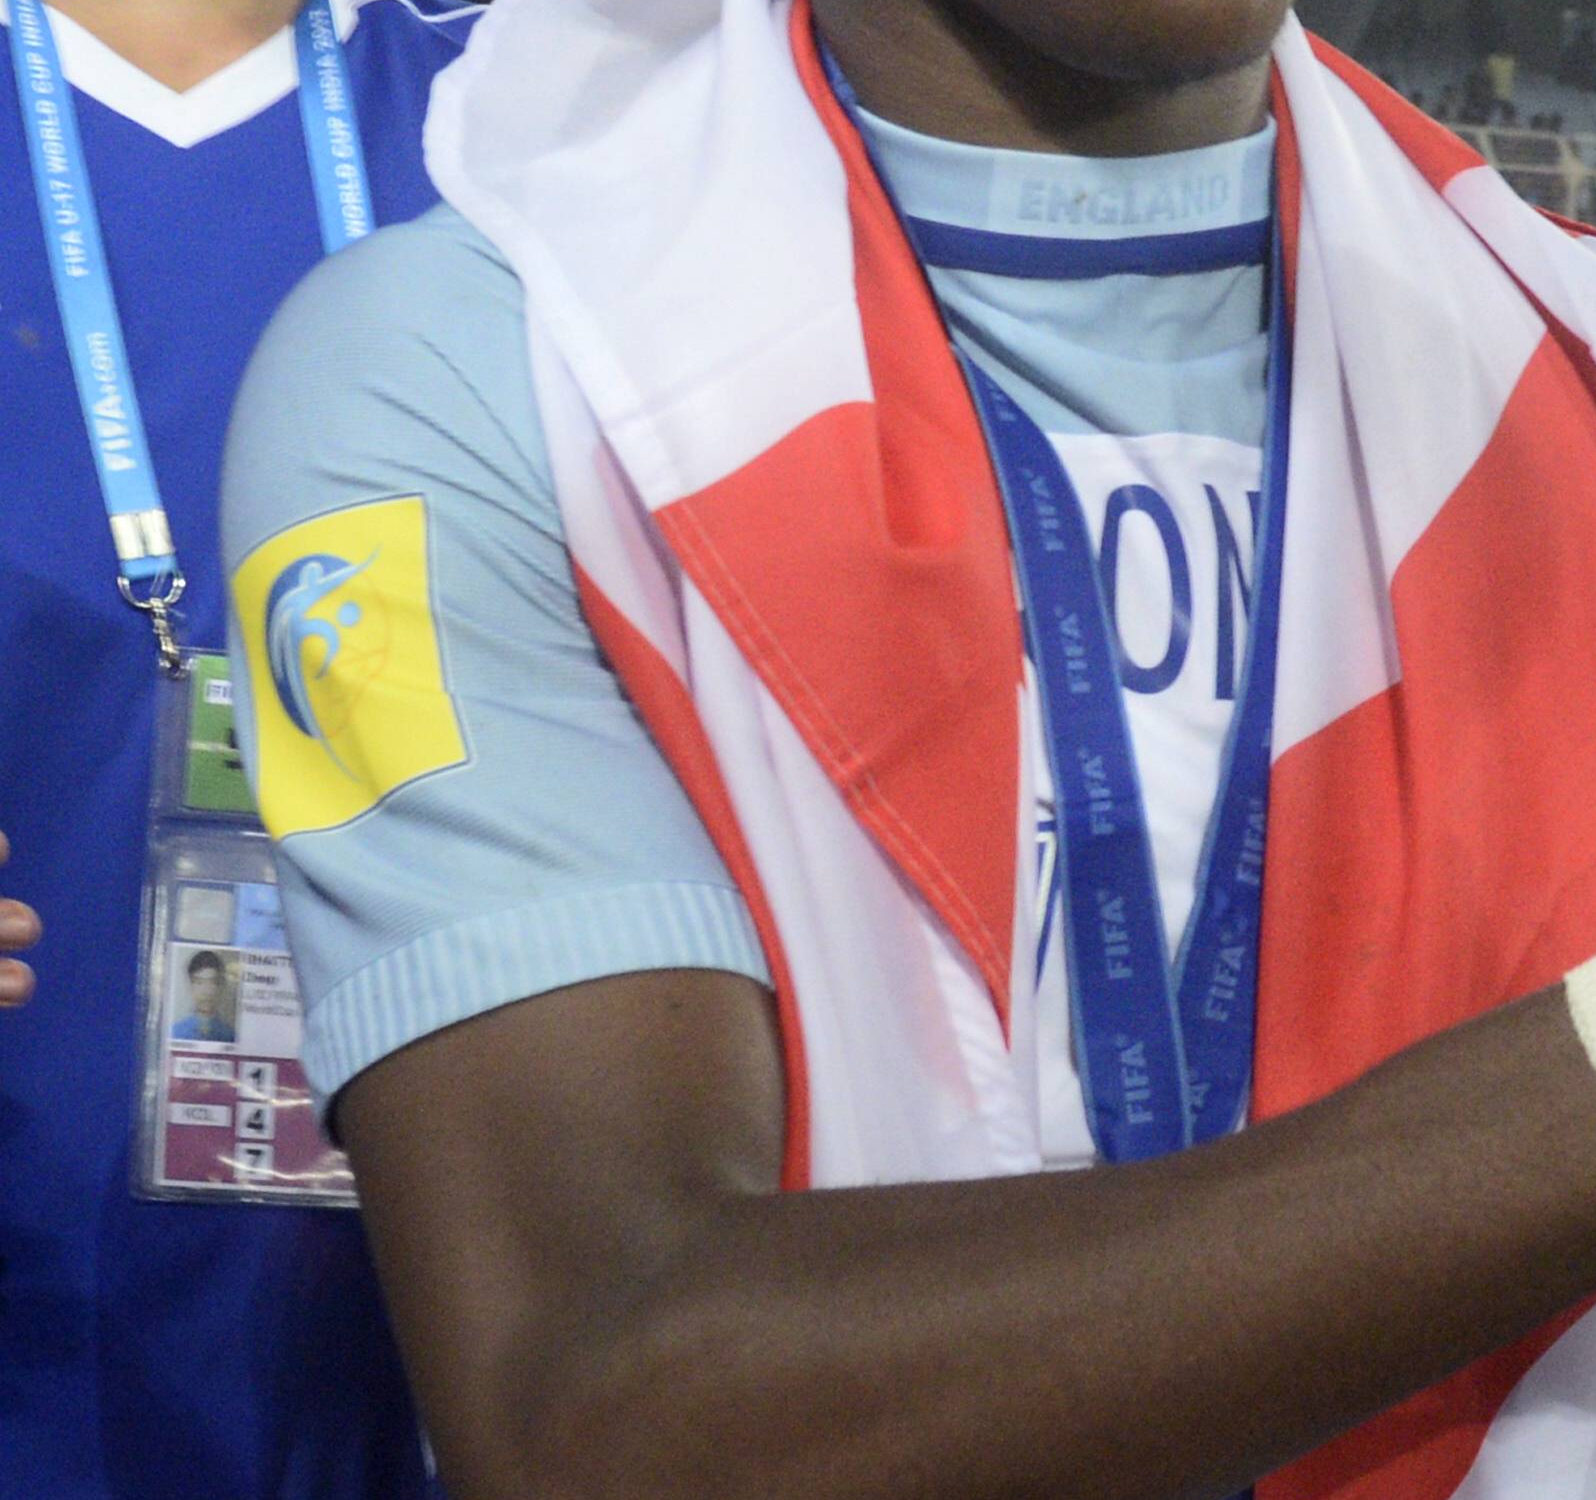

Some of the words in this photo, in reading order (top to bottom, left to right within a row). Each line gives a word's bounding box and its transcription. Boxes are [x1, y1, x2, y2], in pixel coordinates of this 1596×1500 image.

[26, 51, 54, 95] CUP
[316, 53, 348, 113] INDIA
[35, 97, 69, 174] WORLD
[327, 115, 354, 159] CUP
[50, 179, 80, 226] U-17
[334, 162, 369, 238] WORLD
[1016, 173, 1229, 225] ENGLAND
[59, 230, 89, 278] FIFA
[1060, 611, 1092, 695] FIFA
[1083, 753, 1115, 837] FIFA
[1102, 895, 1134, 980] FIFA
[1206, 944, 1247, 1023] FIFA
[1121, 1039, 1155, 1125] FIFA
